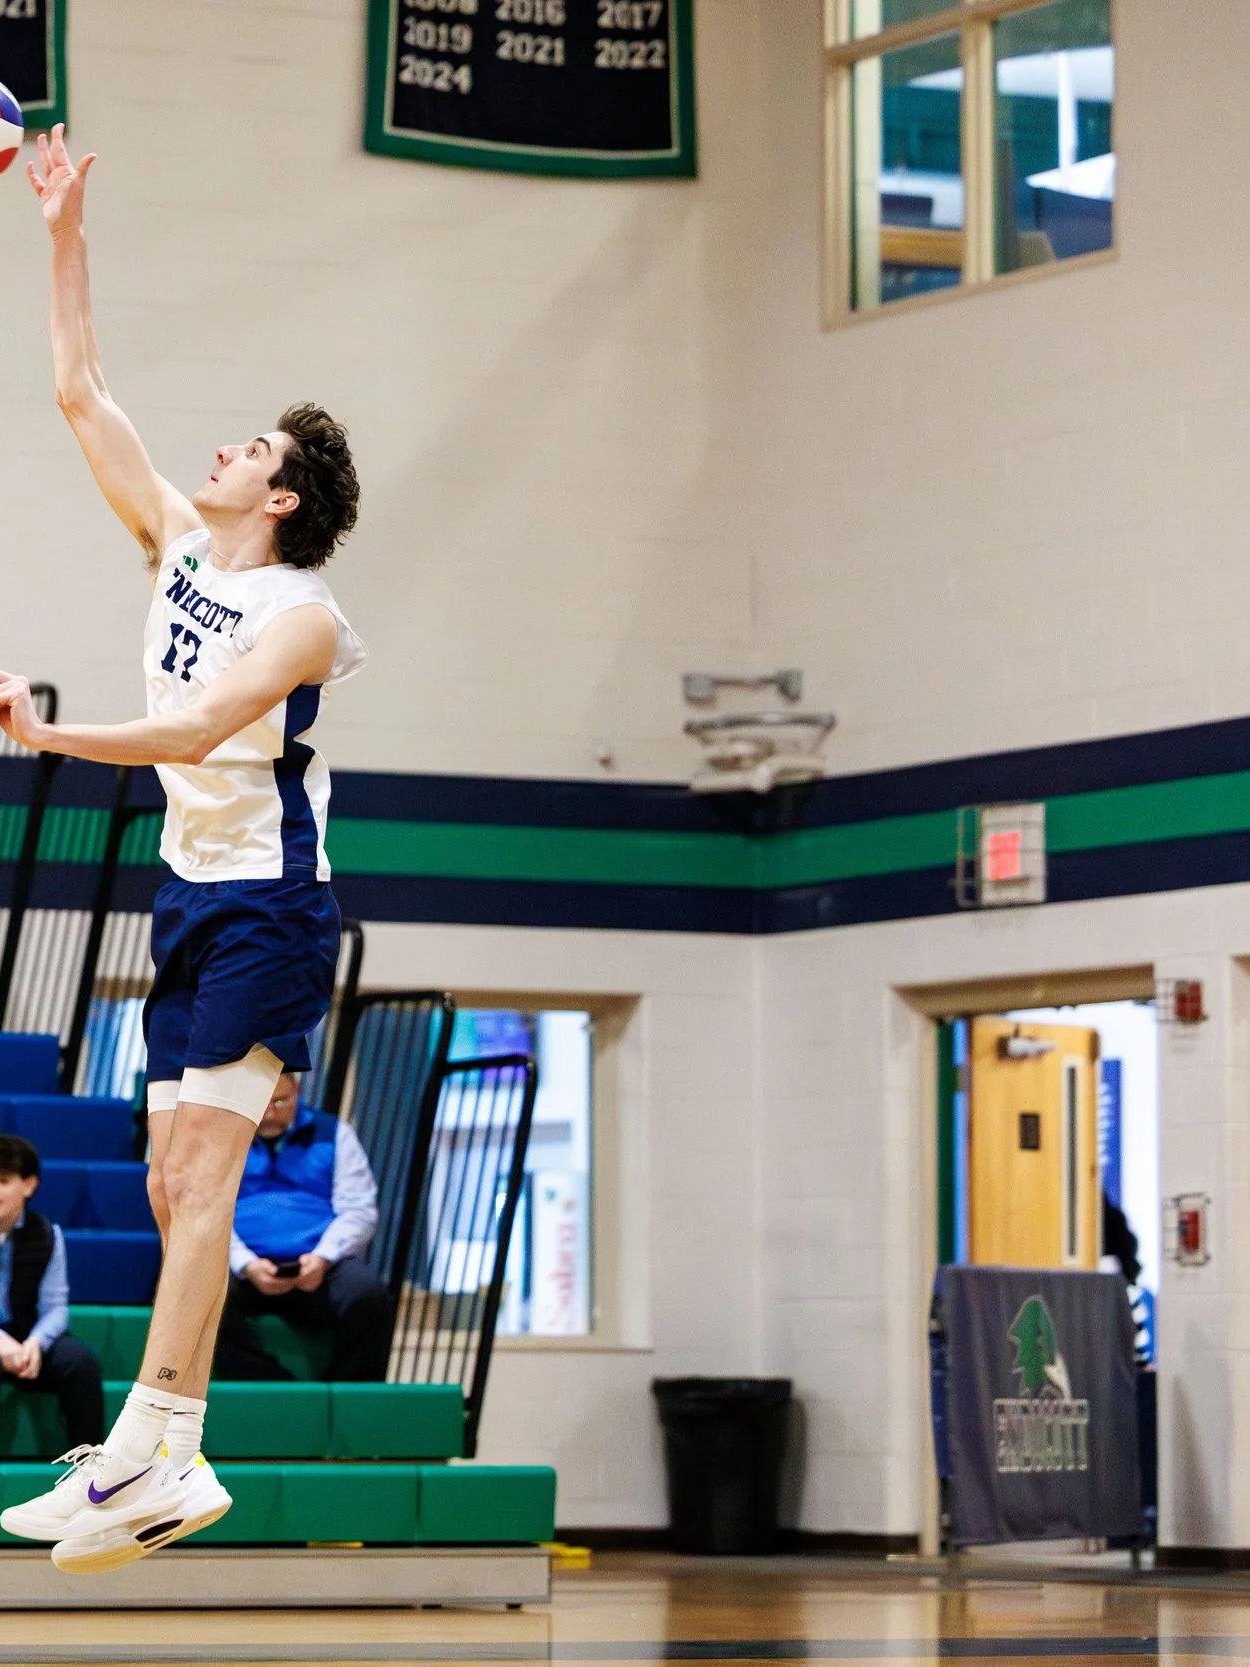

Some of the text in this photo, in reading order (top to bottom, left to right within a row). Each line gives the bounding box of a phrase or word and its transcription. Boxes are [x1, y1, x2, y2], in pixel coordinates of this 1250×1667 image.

[494, 0, 566, 26] 2016
[596, 0, 662, 30] 2017
[403, 16, 666, 69] 2019 2021 2022
[399, 54, 472, 94] 2024
